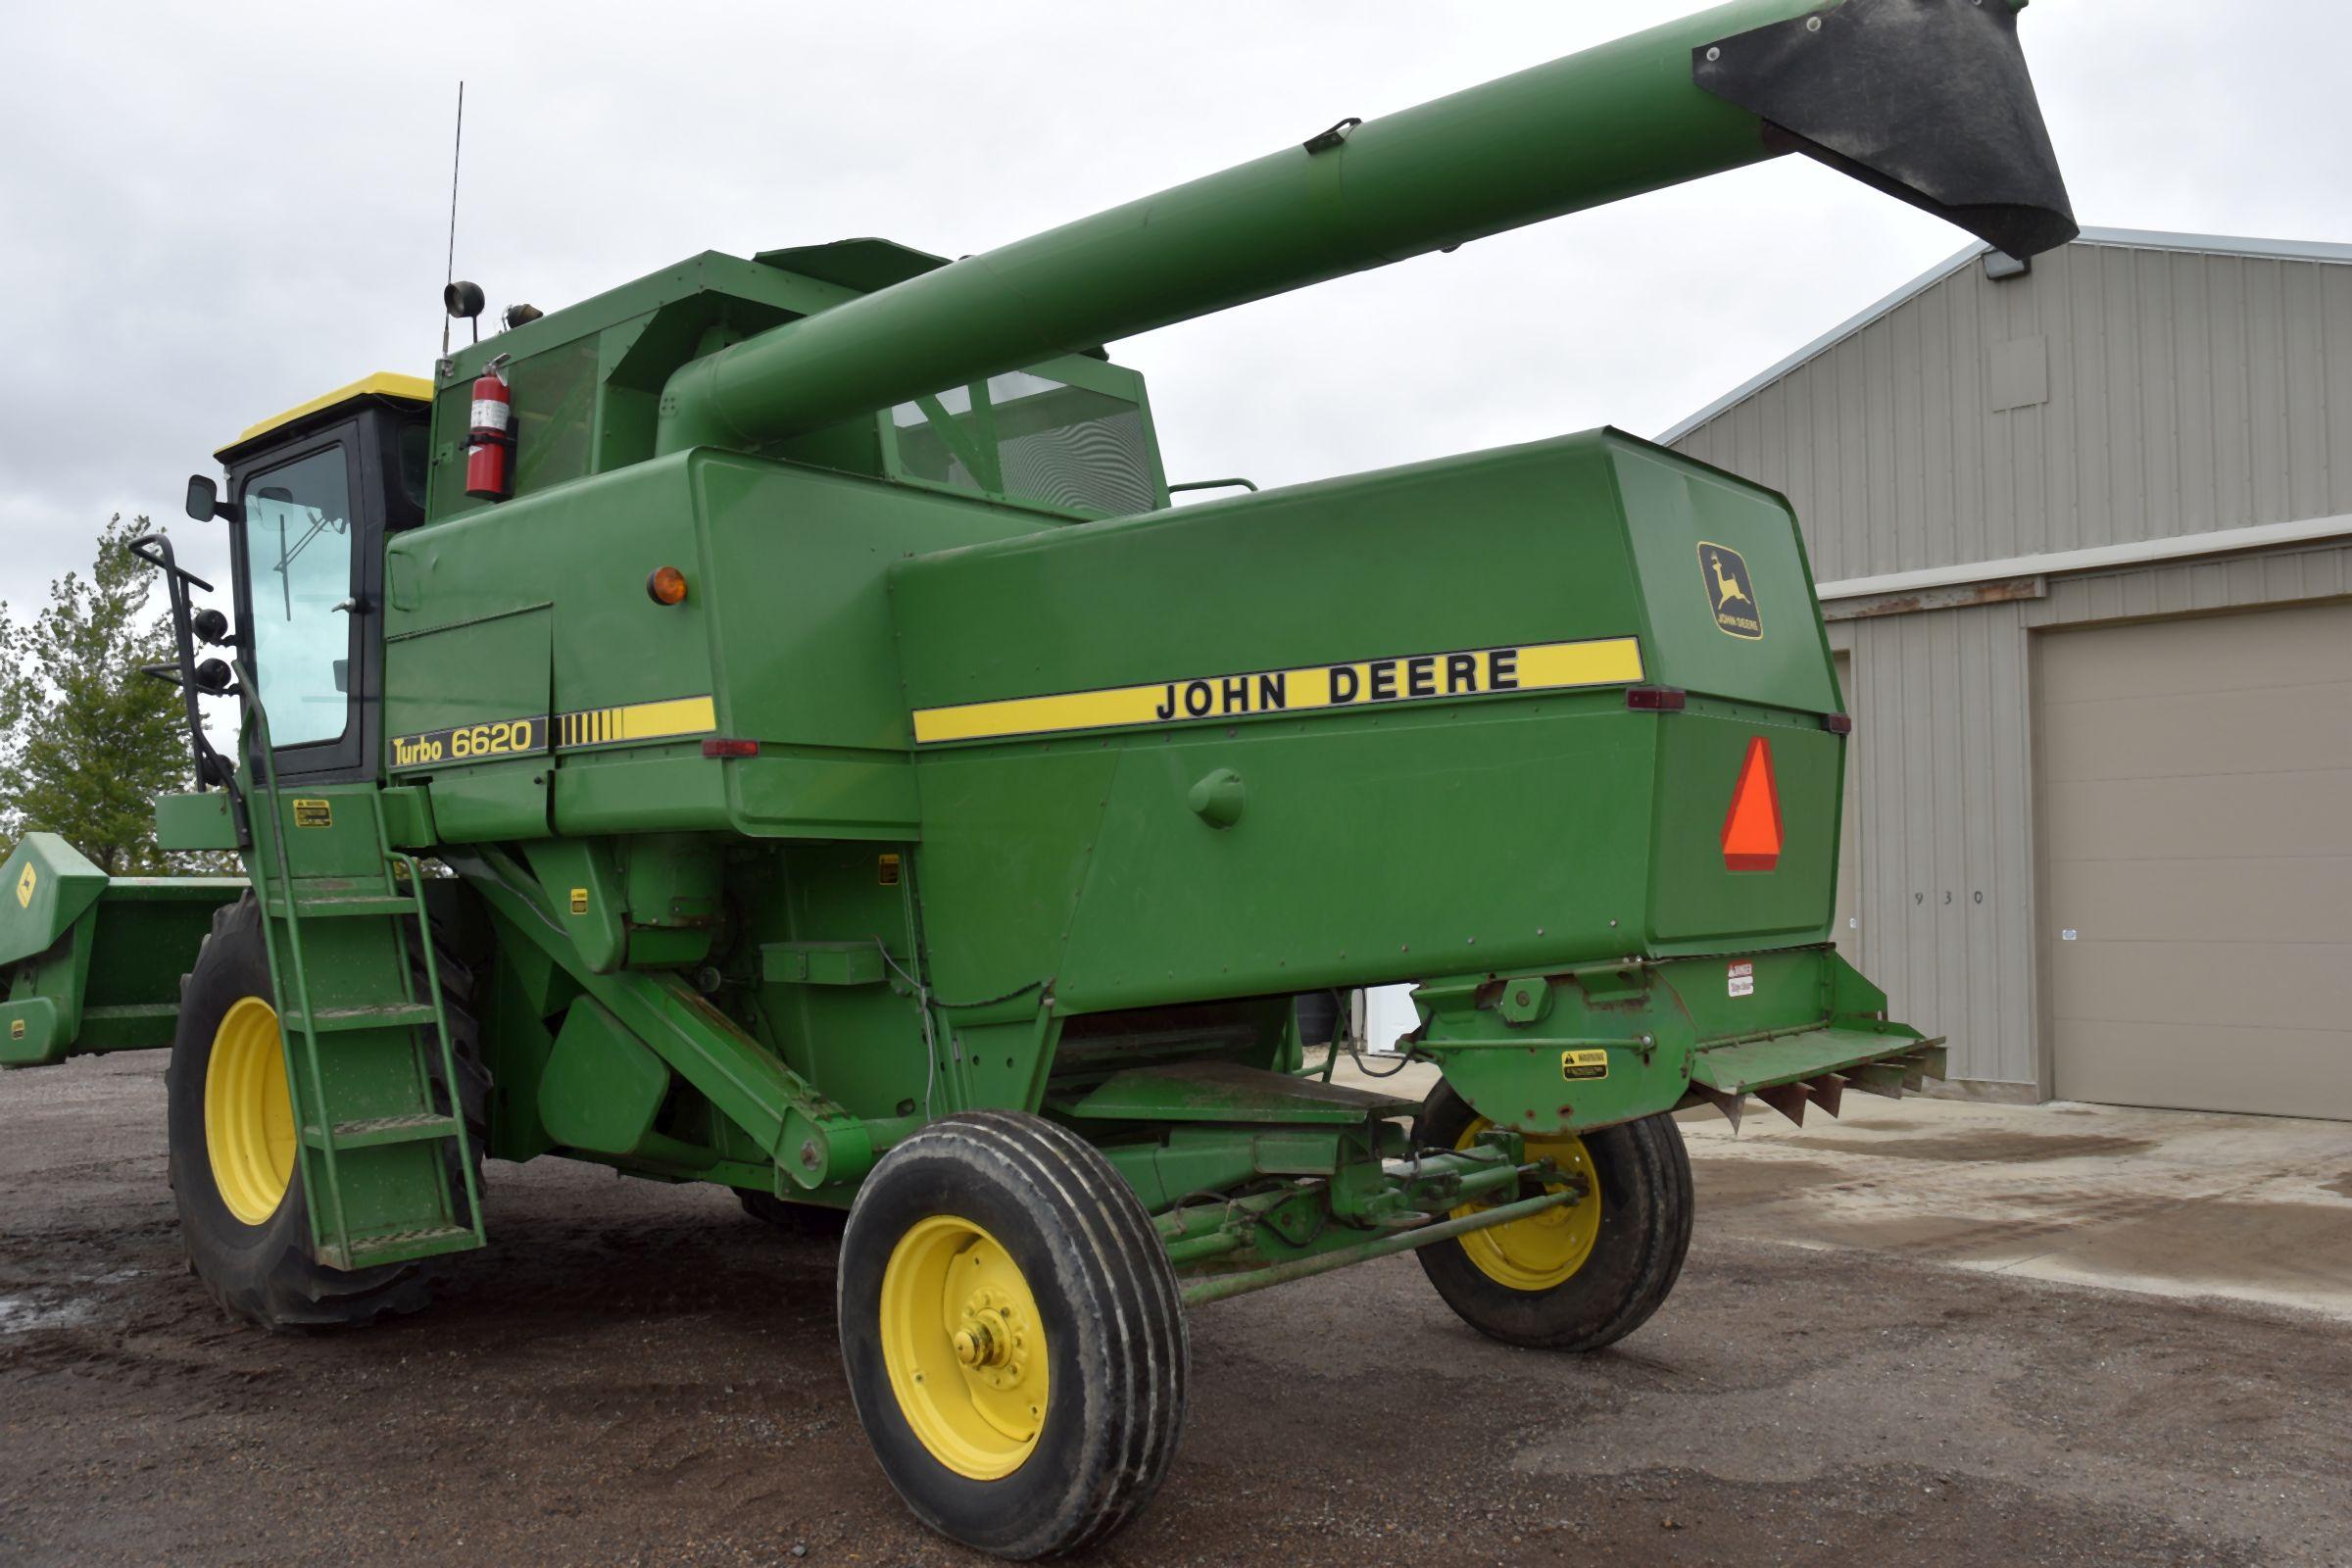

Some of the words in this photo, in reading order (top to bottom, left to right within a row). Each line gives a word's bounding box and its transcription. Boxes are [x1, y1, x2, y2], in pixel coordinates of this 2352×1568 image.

[1156, 674, 1287, 720] JOHN
[1330, 650, 1520, 706] DEERE
[393, 735, 442, 766] Turbo
[451, 720, 532, 758] 6620
